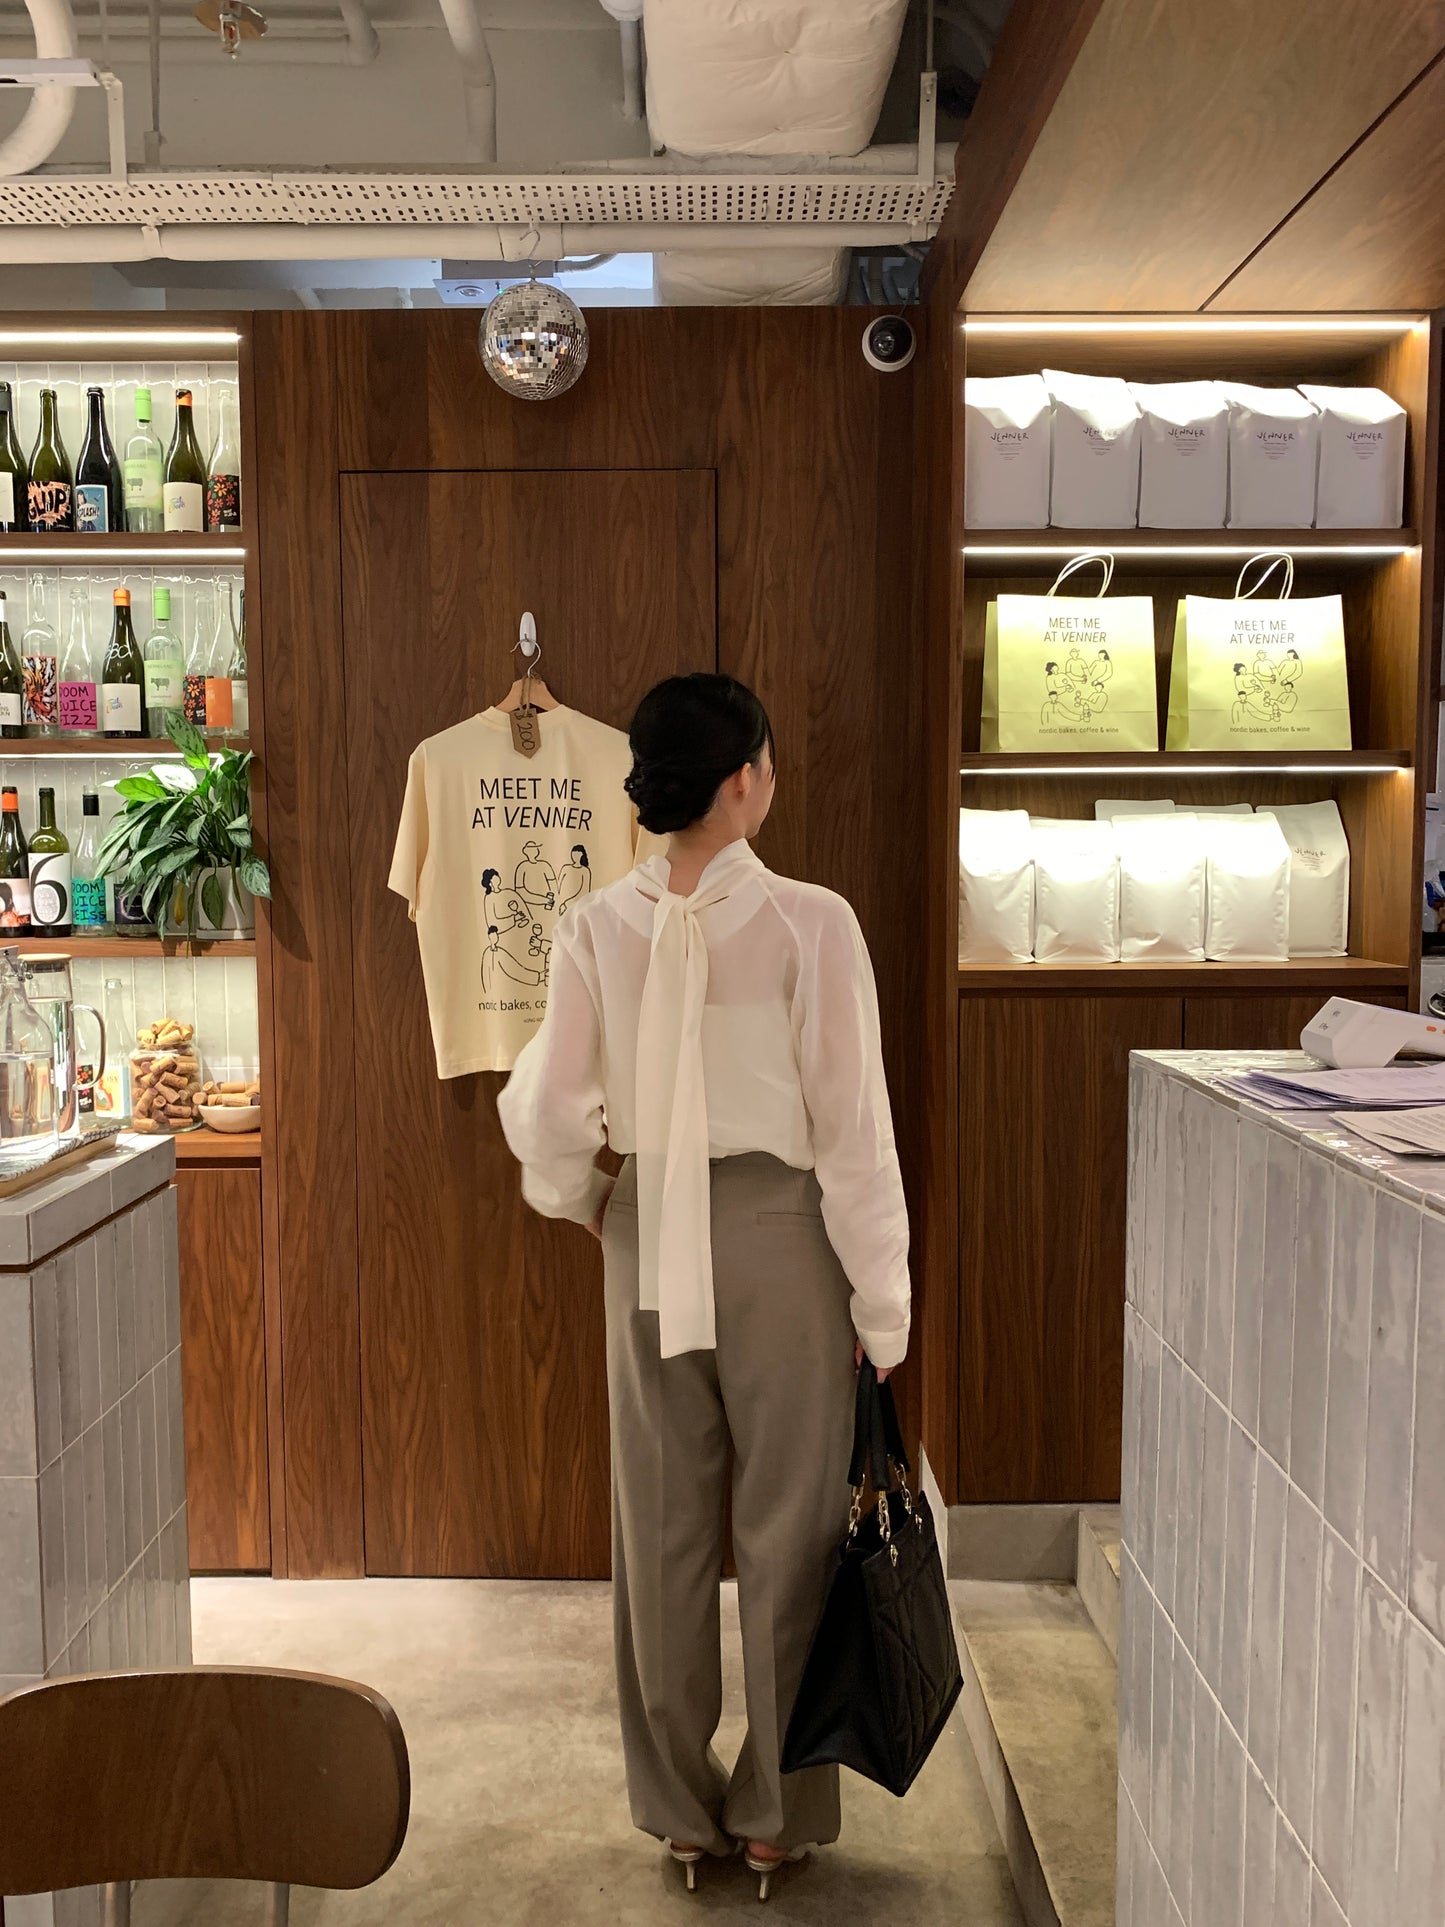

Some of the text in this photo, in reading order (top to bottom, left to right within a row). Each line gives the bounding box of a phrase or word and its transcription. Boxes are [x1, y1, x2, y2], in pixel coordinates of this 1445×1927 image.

[1049, 617, 1101, 629] MEET ME
[1234, 620, 1287, 631] MEET ME
[1043, 631, 1107, 642] AT VENNER
[1229, 632, 1295, 644] AT VENNER
[60, 700, 96, 711] UICE
[60, 715, 96, 726] IZZ
[1079, 726, 1099, 734] coffee
[1269, 725, 1289, 733] coffee
[480, 778, 581, 801] MEET ME
[472, 806, 593, 832] AT VENNER
[31, 853, 68, 925] 6
[72, 895, 105, 907] UICE
[72, 909, 105, 921] EISS
[500, 999, 532, 1011] bakes,
